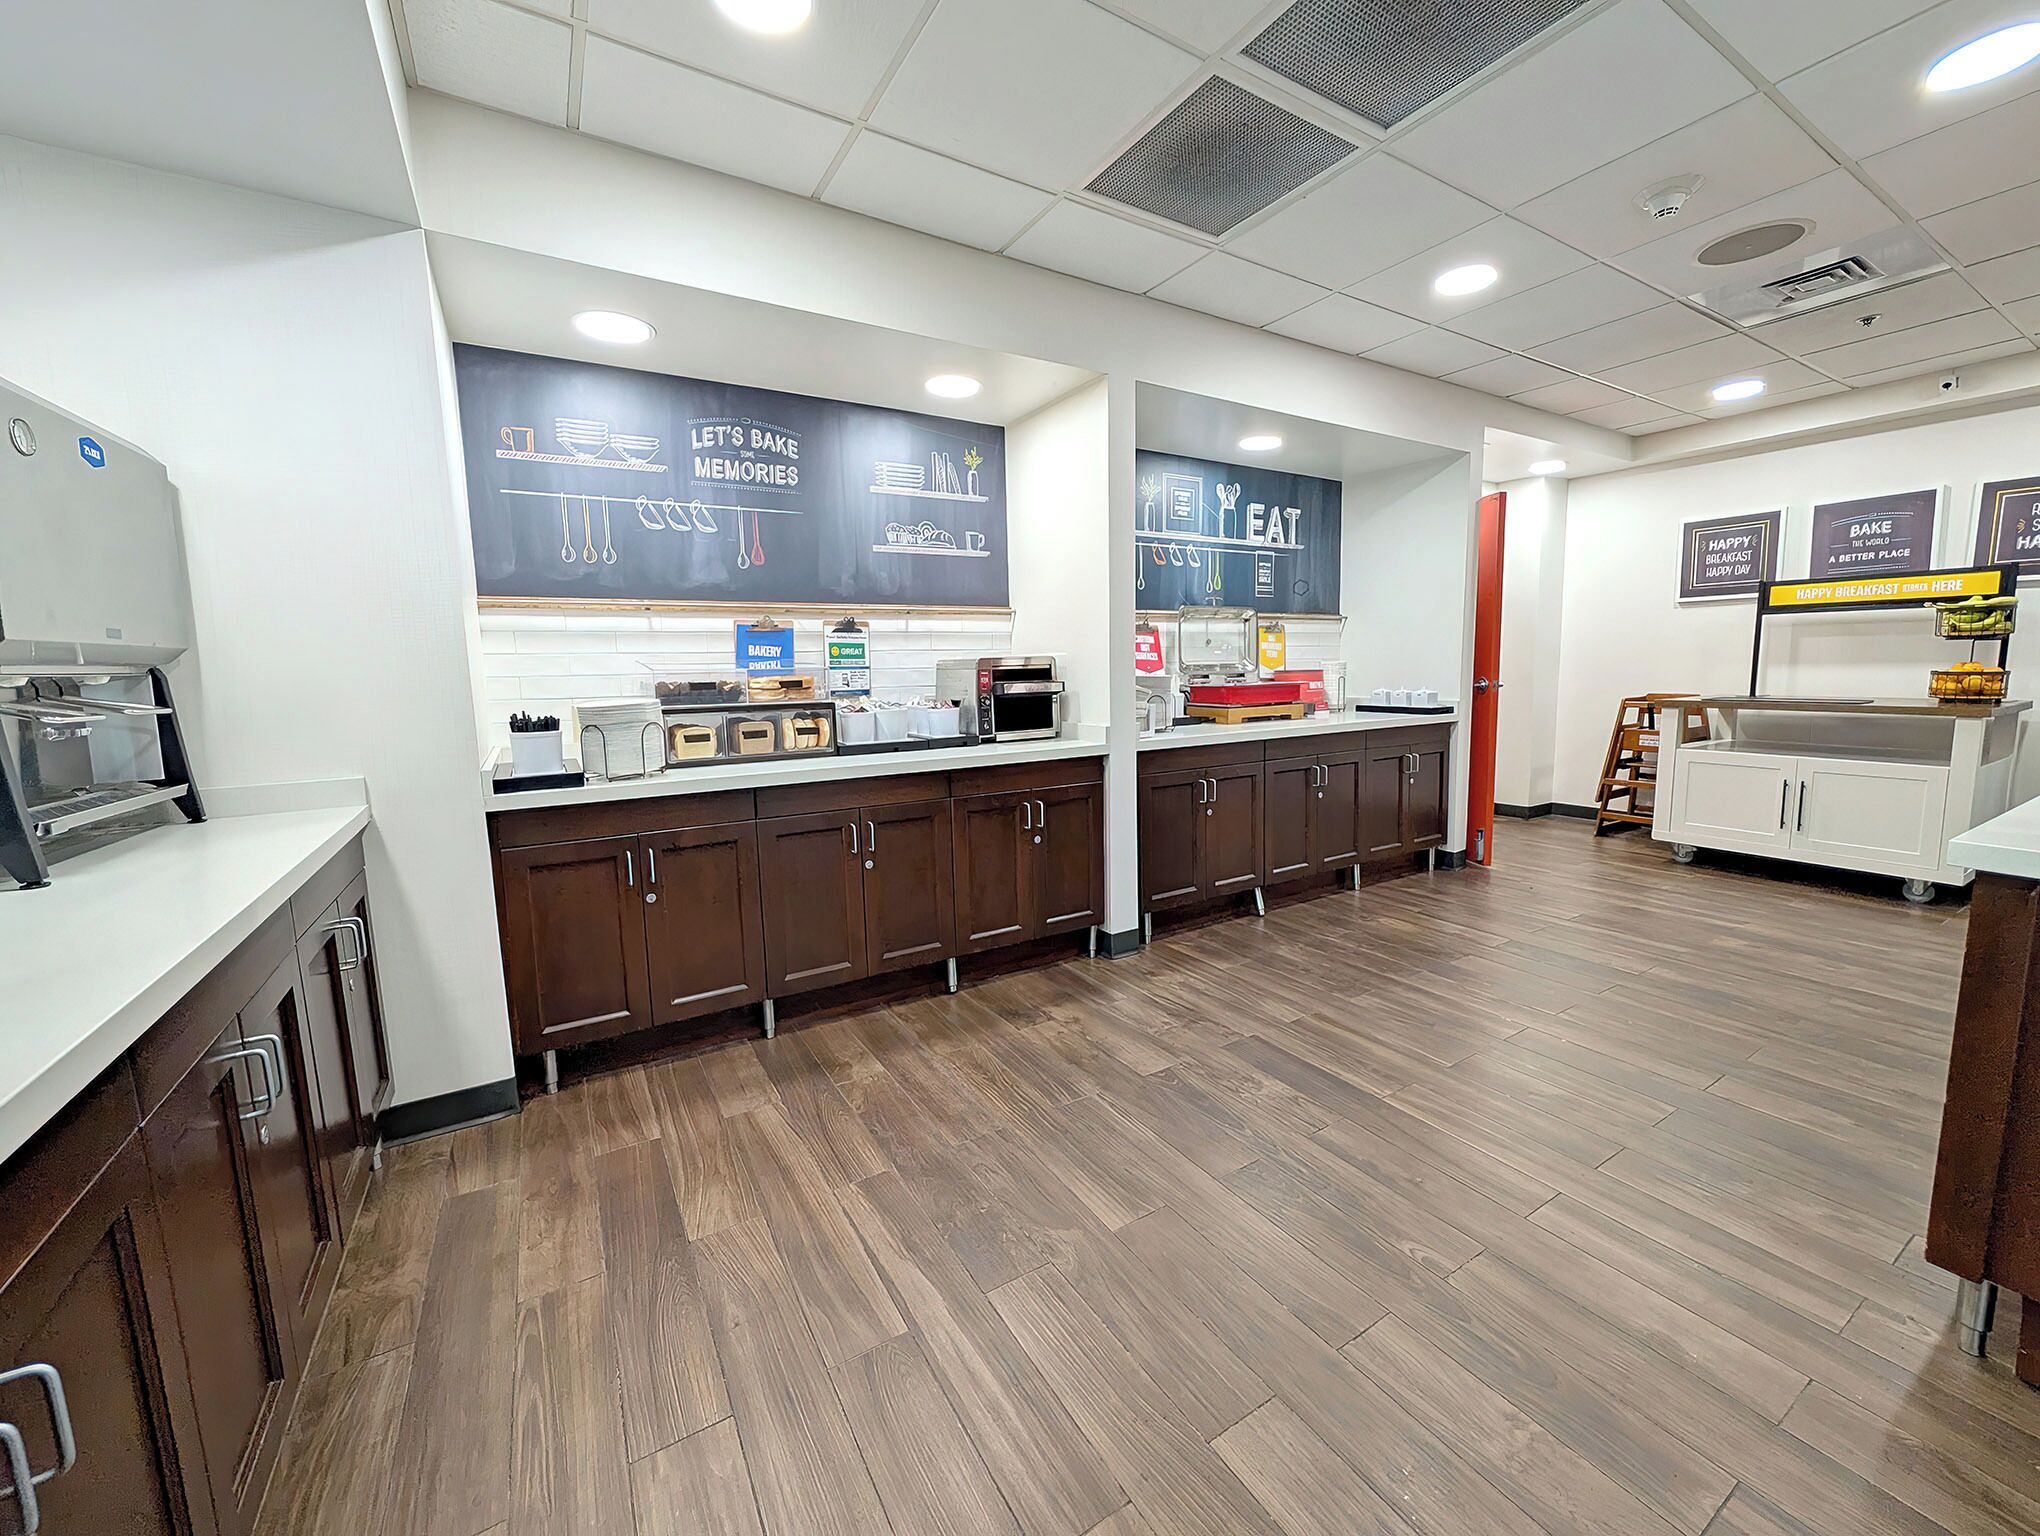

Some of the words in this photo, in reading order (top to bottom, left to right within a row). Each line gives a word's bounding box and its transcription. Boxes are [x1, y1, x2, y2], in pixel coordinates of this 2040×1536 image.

[690, 425, 744, 450] LET'S
[750, 428, 800, 460] BAKE
[694, 456, 800, 486] MEMORIES
[1246, 502, 1302, 545] EAT
[1850, 520, 1893, 538] BAKE
[1708, 535, 1752, 551] HAPPY
[1865, 537, 1890, 547] WORLD
[1705, 549, 1753, 565] BREAKFAST
[1828, 555, 1836, 564] A
[1838, 551, 1875, 563] BETTER
[1878, 548, 1911, 559] PLACE
[1705, 565, 1734, 578] HAPPY
[1734, 563, 1752, 576] DAY
[1796, 587, 1833, 600] HAPPY
[1835, 583, 1900, 598] BREAKFAST
[1931, 579, 1963, 592] HERE
[748, 644, 782, 658] BAKERY
[840, 647, 863, 656] GREAT
